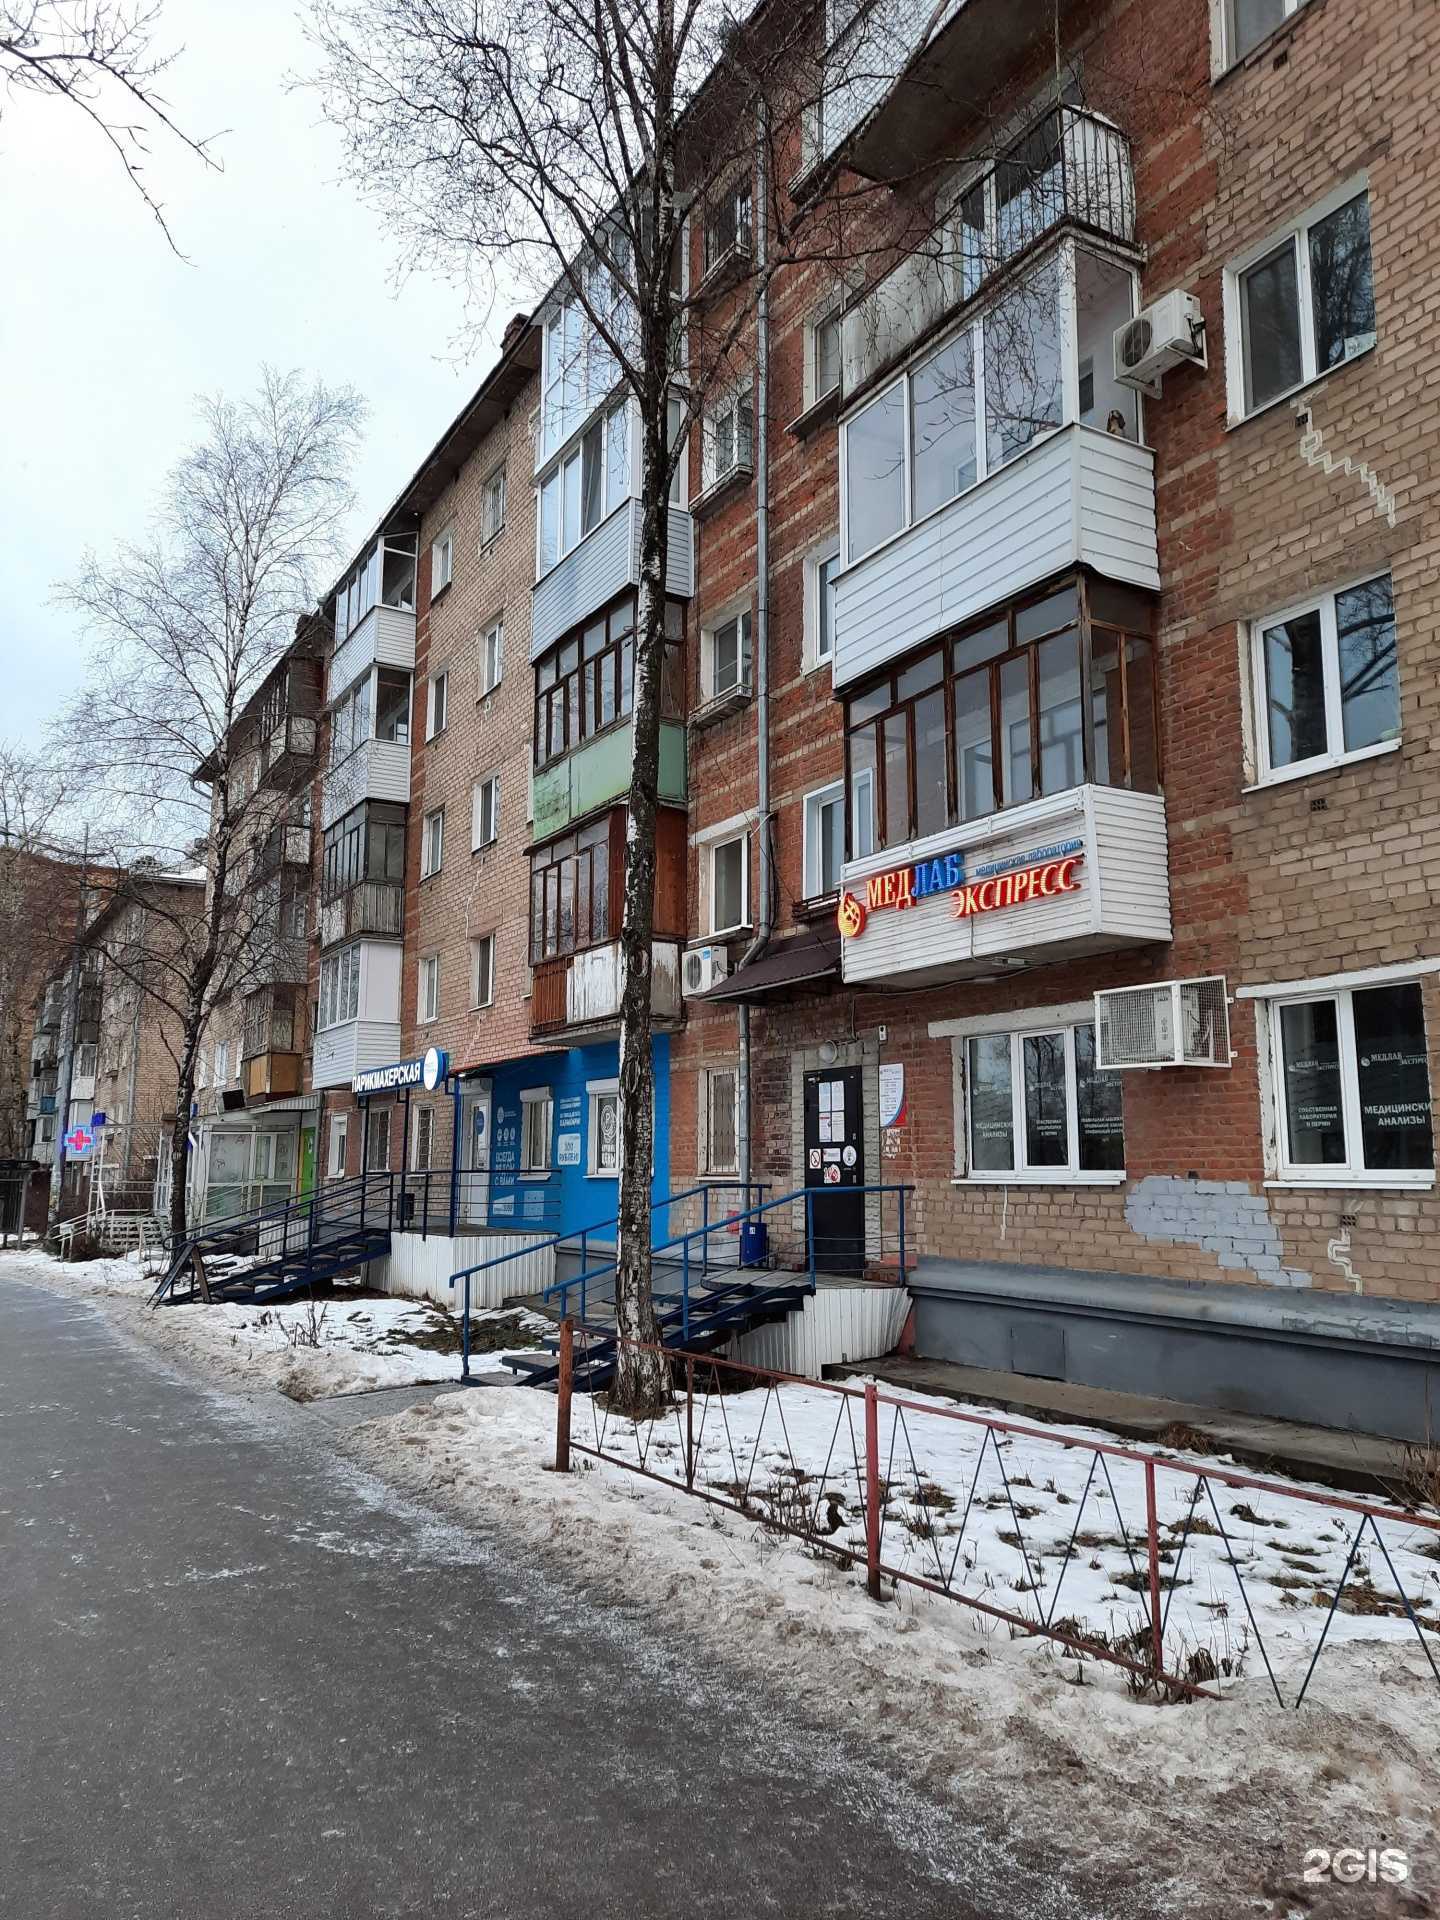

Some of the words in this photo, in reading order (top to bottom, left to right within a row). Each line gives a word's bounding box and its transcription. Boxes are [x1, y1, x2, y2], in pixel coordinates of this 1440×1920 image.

[949, 859, 1081, 918] ЭКСПРЕСС
[352, 1062, 421, 1093] ПАРИКМАХЕРСКАЯ
[1364, 1102, 1431, 1114] МЕДИЦИНСКИ
[1378, 1115, 1426, 1126] АНАЛИЗЫ
